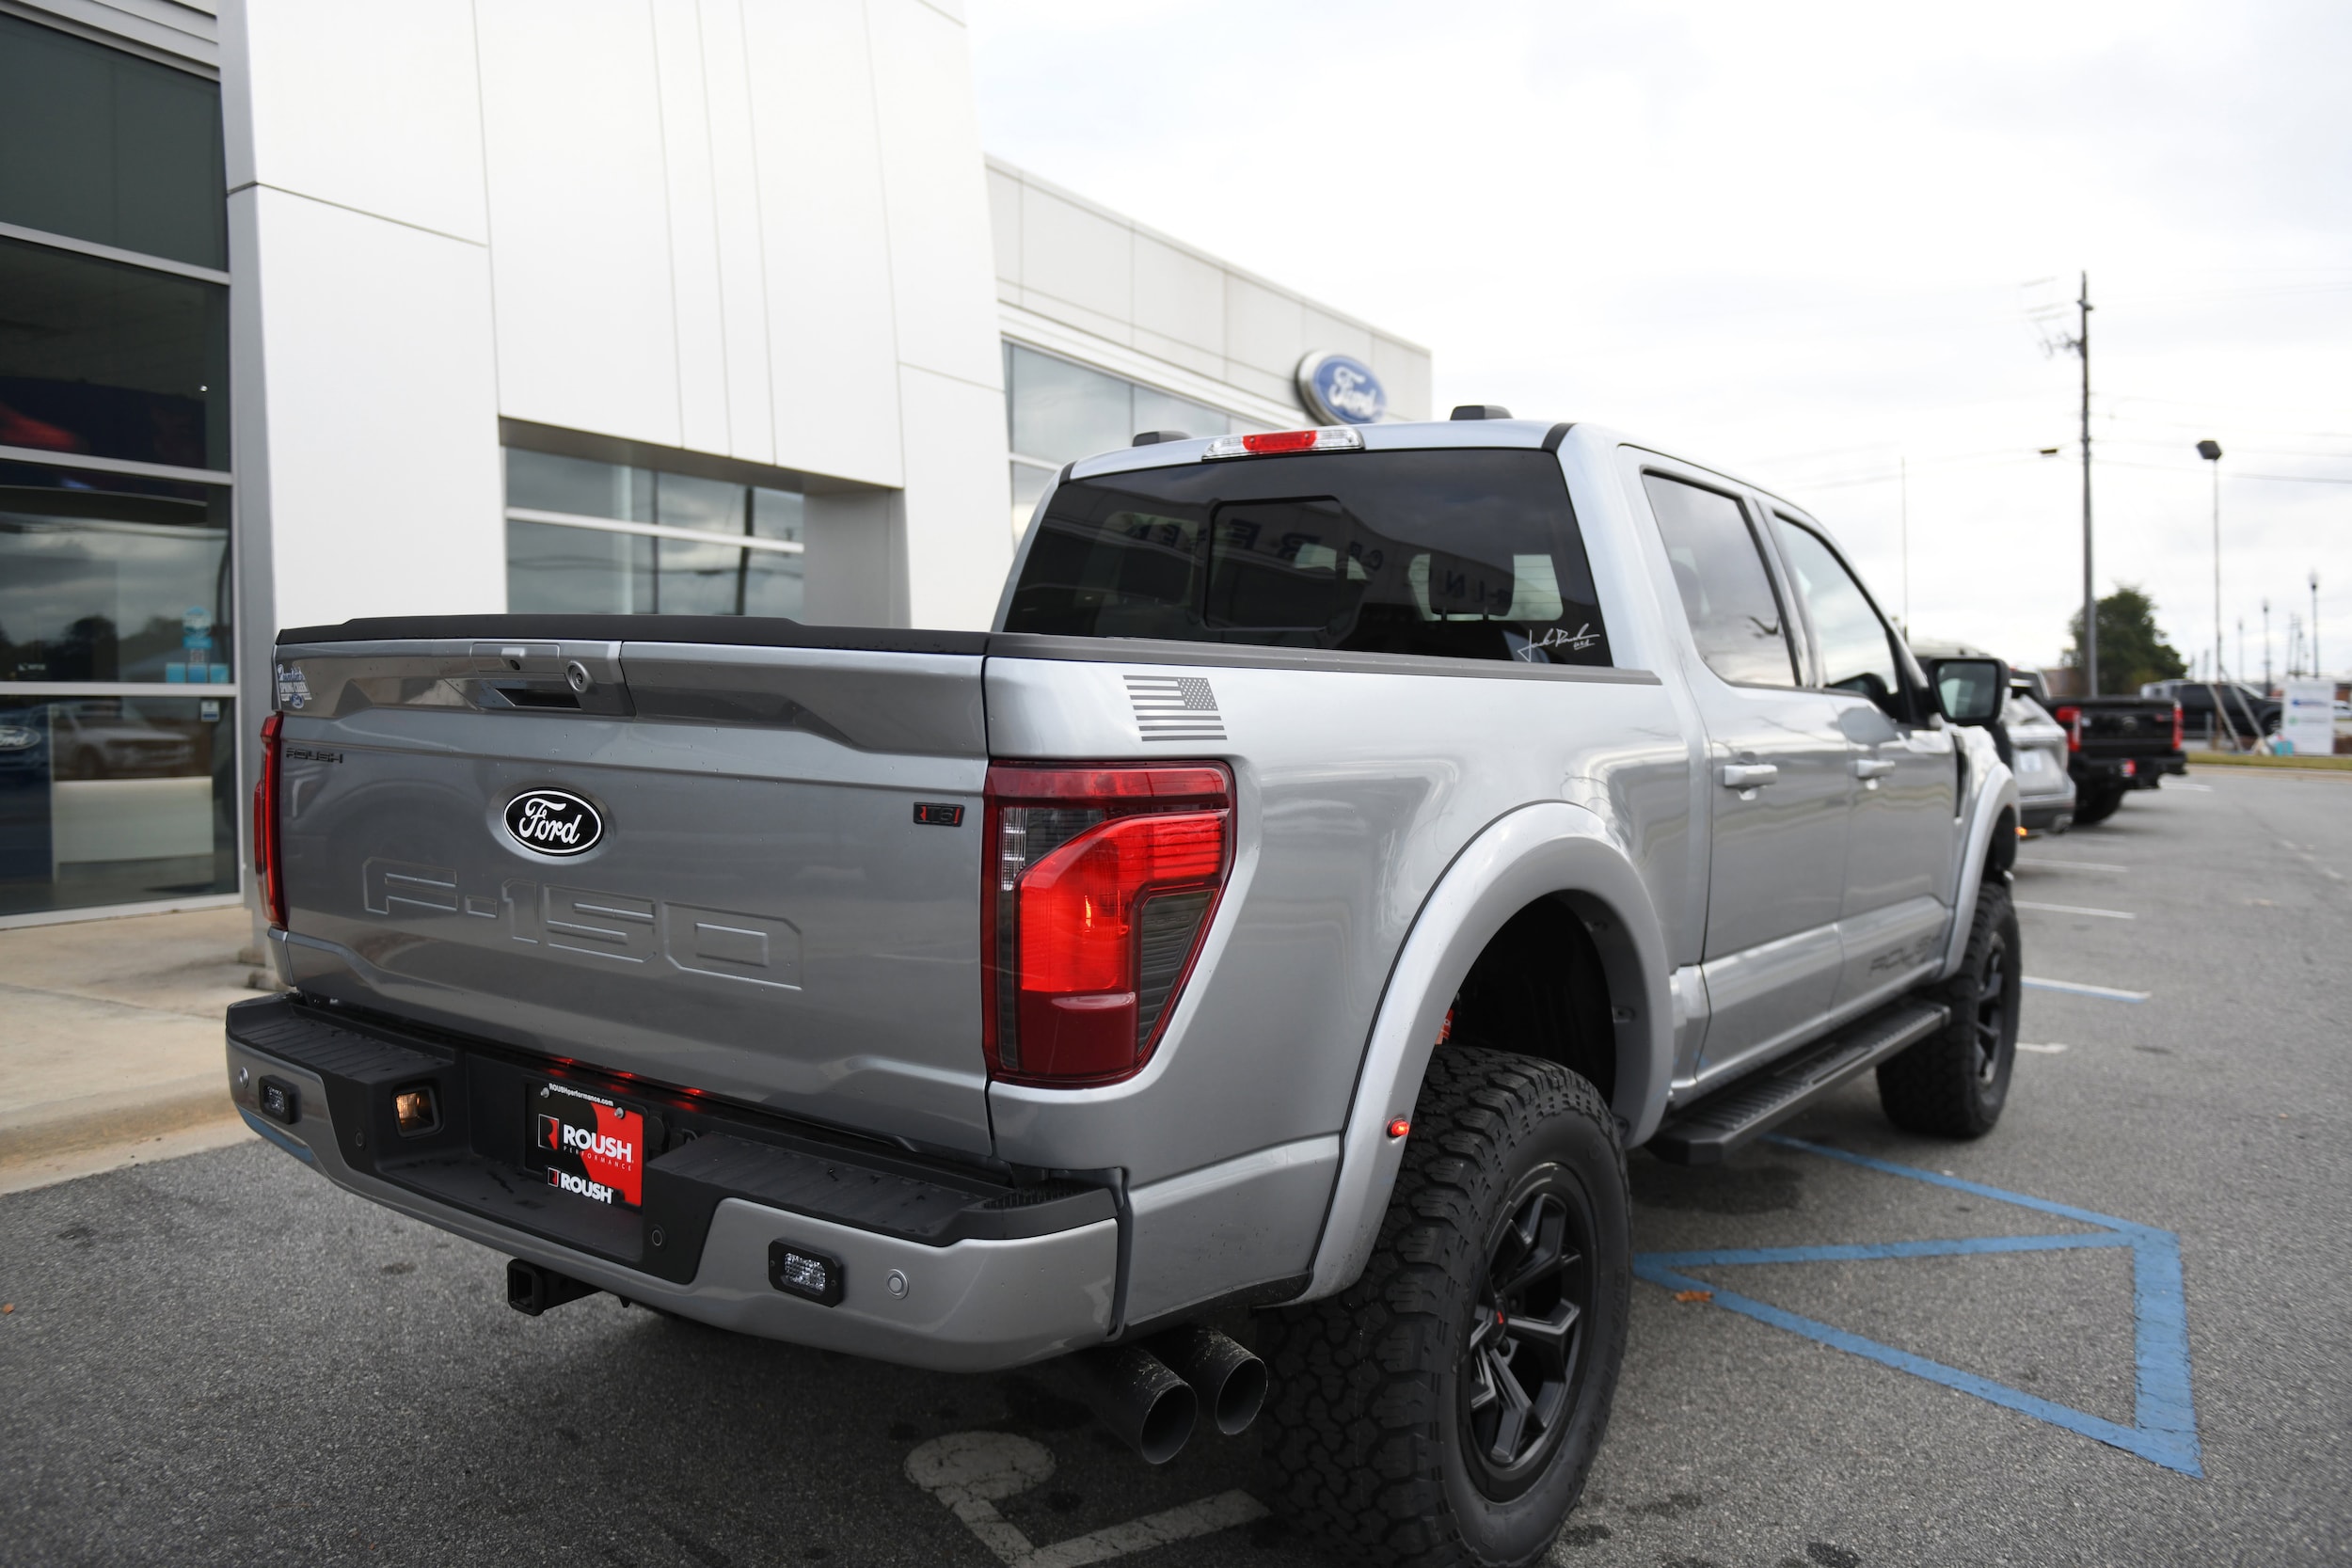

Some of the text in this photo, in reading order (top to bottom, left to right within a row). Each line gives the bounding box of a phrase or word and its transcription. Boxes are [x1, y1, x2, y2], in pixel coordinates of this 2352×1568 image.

[1328, 366, 1376, 415] Ford
[286, 747, 343, 764] ROUSH
[518, 798, 581, 844] Ford
[363, 856, 803, 991] F-150
[548, 1083, 614, 1107] ROUSHperformance.com
[563, 1124, 632, 1164] ROUSH
[563, 1146, 632, 1172] PERFORMANCE
[560, 1172, 612, 1204] ROUSH
